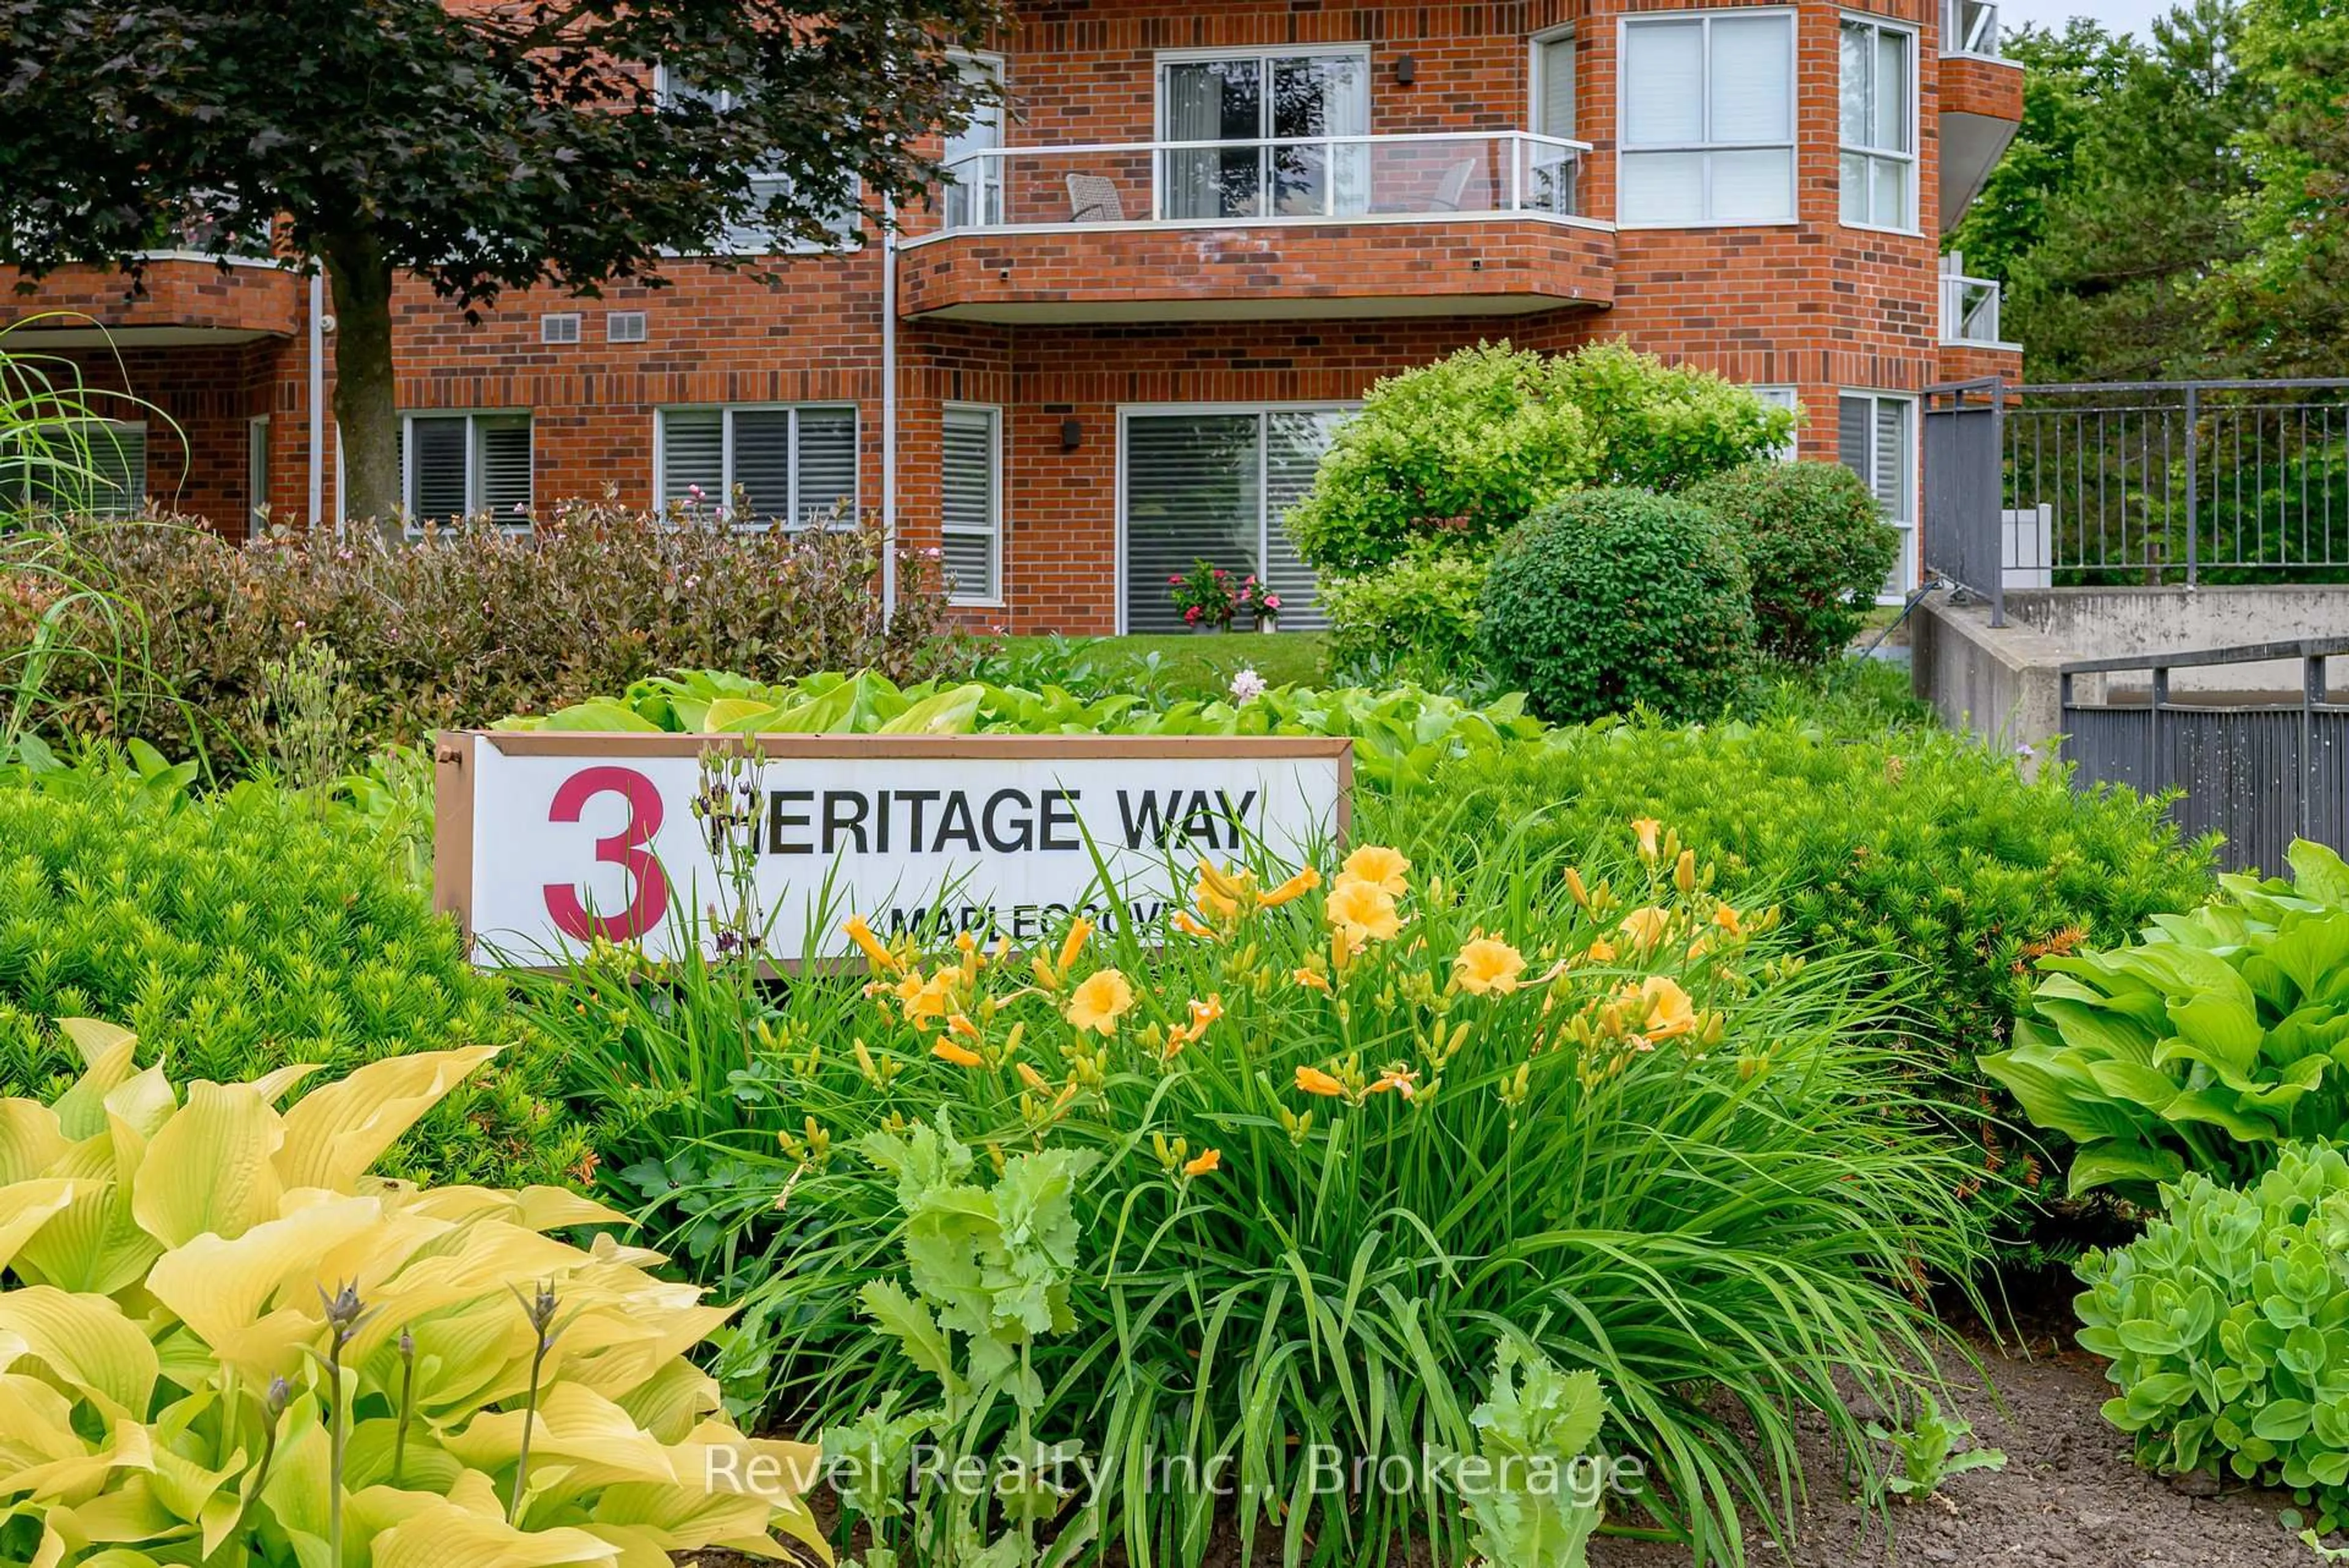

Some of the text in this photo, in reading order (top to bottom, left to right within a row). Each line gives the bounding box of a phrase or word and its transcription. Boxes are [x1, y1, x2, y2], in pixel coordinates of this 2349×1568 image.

[543, 766, 670, 943] 3
[1116, 789, 1257, 851] WAY
[891, 902, 1179, 944] MAPLEOV
